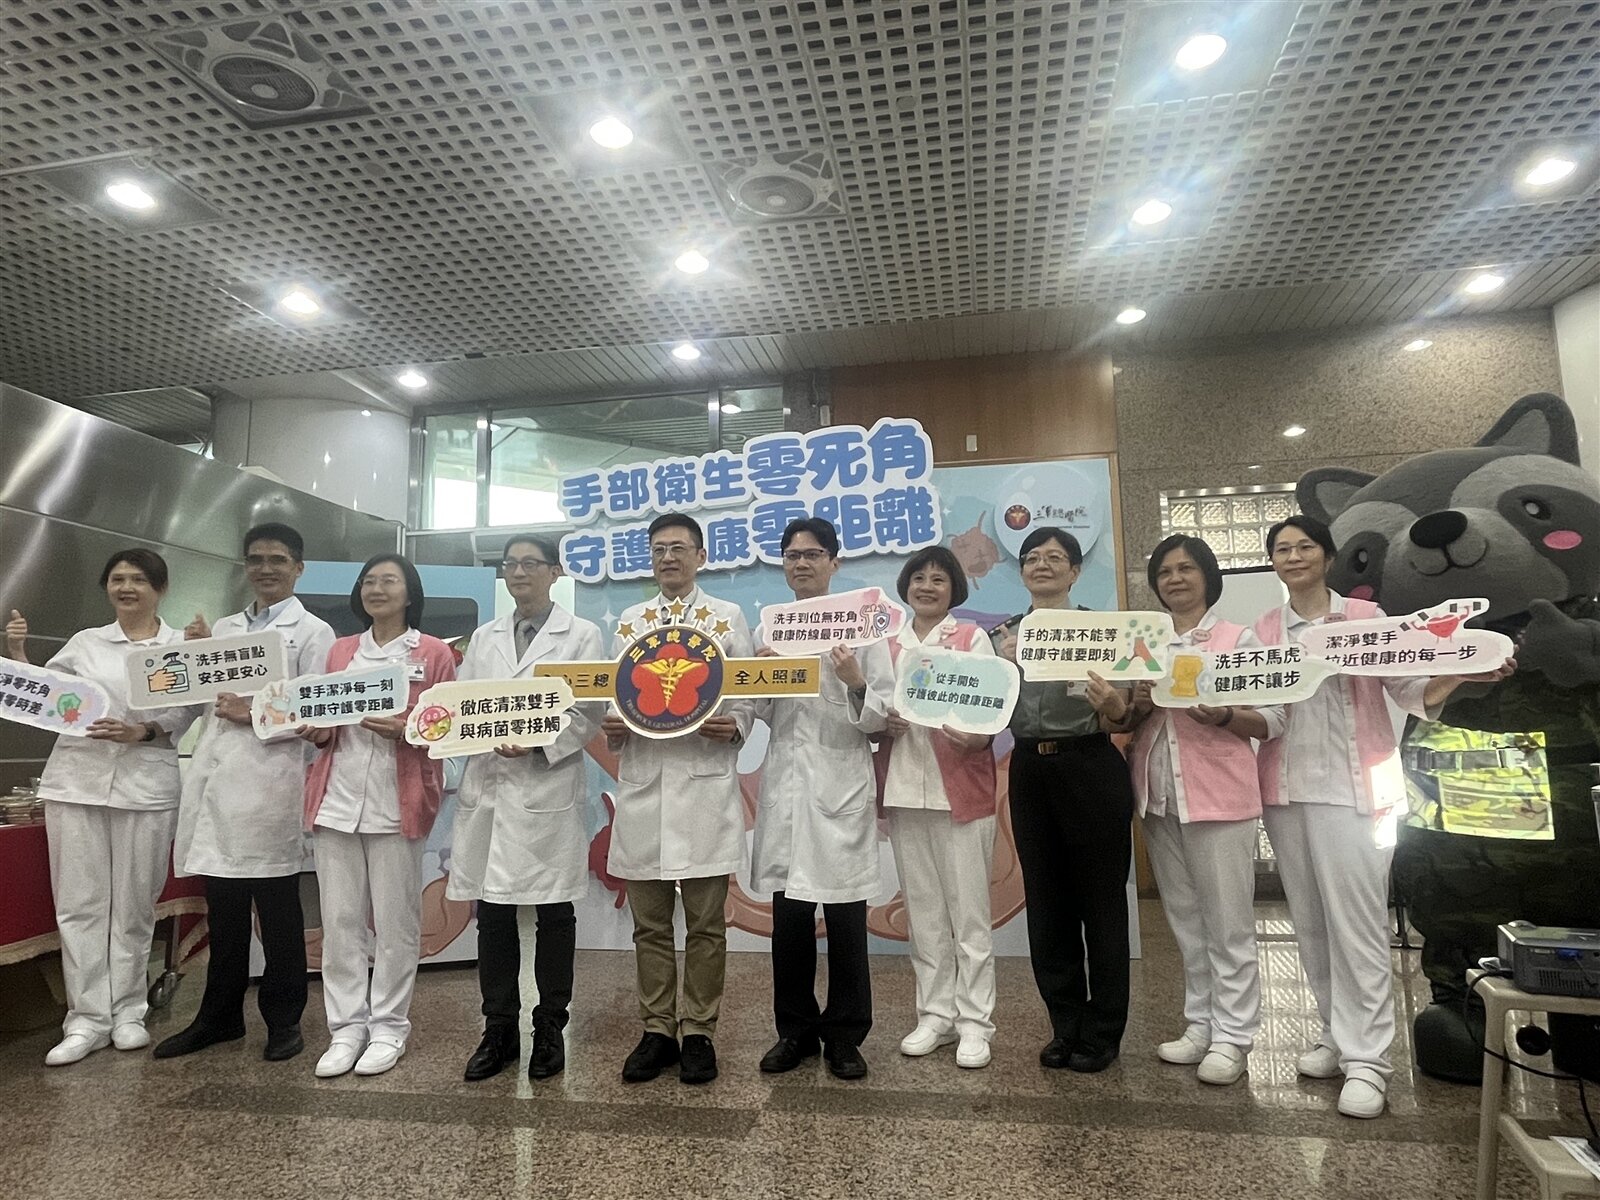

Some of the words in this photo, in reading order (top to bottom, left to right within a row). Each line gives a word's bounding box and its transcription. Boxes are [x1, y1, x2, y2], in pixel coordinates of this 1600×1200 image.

[563, 423, 926, 518] 手部衛生零死角
[565, 486, 936, 577] 守護康零距離
[774, 610, 857, 624] 洗手到位無死角
[772, 627, 857, 642] 健康防線最可靠
[1023, 628, 1118, 642] 手的清潔不能等
[1326, 630, 1398, 649] 潔淨雙手
[195, 645, 266, 667] 洗手無盲點
[1021, 647, 1116, 662] 健康守護要即刻
[1215, 647, 1301, 670] 洗手不馬虎
[198, 664, 268, 685] 安全更安心
[544, 673, 609, 688] 三總
[735, 669, 808, 685] 全人照護
[936, 672, 979, 688] 從手開始
[1215, 671, 1300, 693] 健康不讓步
[299, 679, 394, 699] 雙手潔淨每一刻
[906, 687, 1004, 710] 守護彼此的健康距離
[299, 697, 395, 719] 健康守護零距離
[460, 692, 561, 717] 徹底清潔雙手
[460, 715, 561, 740] 與病菌零接觸
